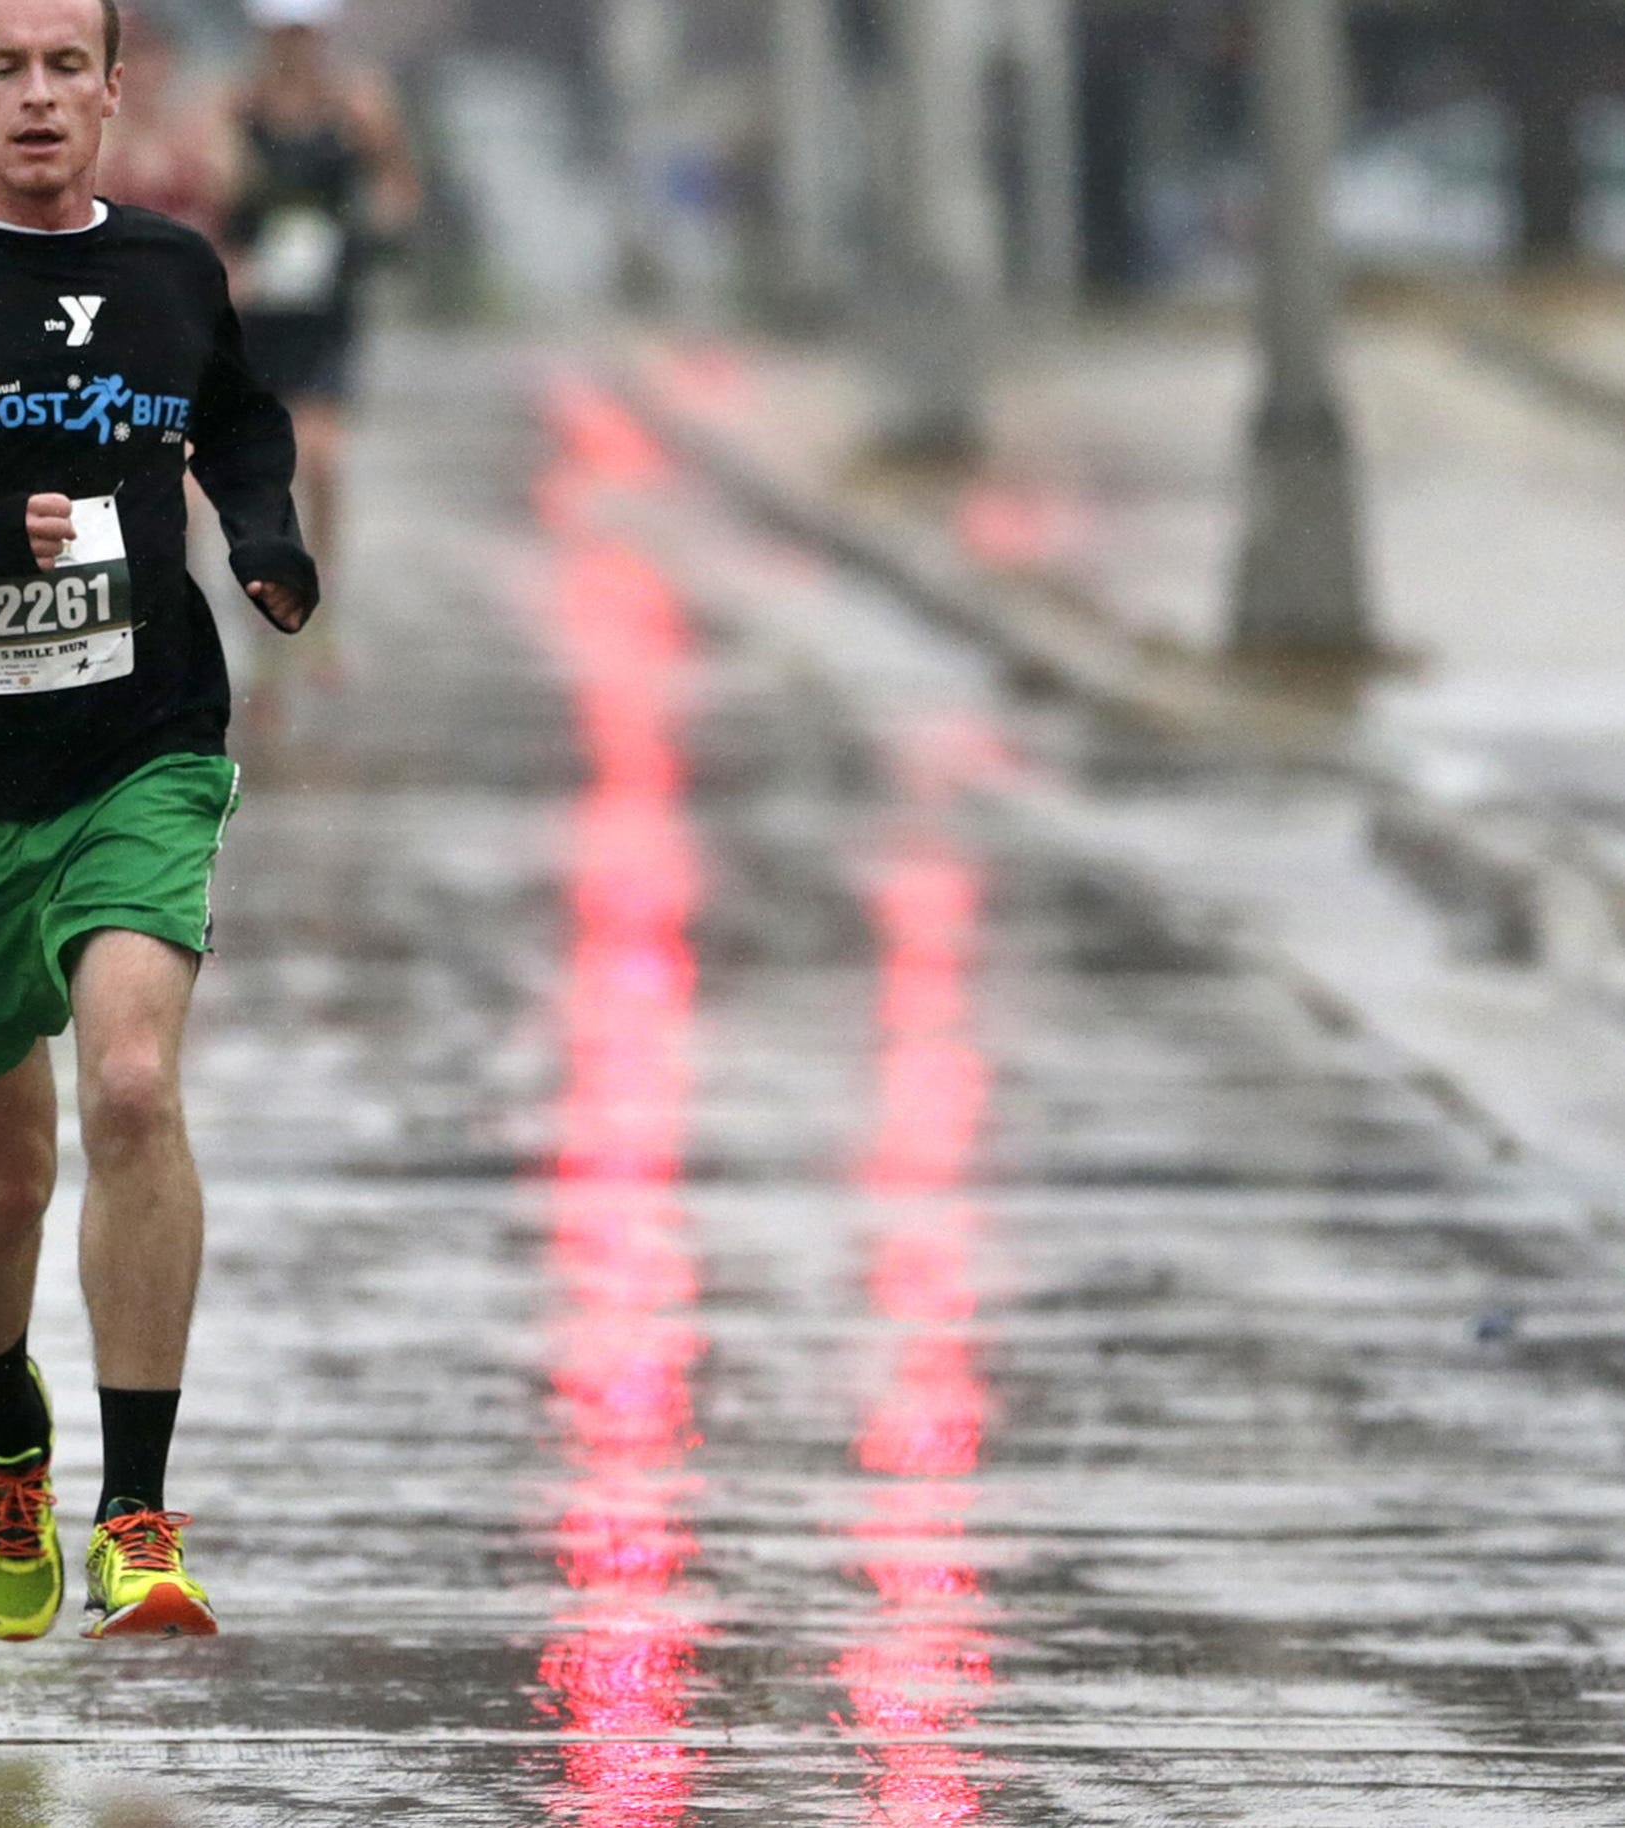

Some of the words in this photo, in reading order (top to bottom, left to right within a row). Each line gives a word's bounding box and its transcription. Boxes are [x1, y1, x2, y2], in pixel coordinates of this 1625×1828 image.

[44, 320, 66, 332] the
[58, 295, 105, 347] Y
[132, 393, 190, 429] BITE
[1, 650, 9, 660] 5
[13, 648, 54, 660] MILE
[59, 640, 88, 655] RUN
